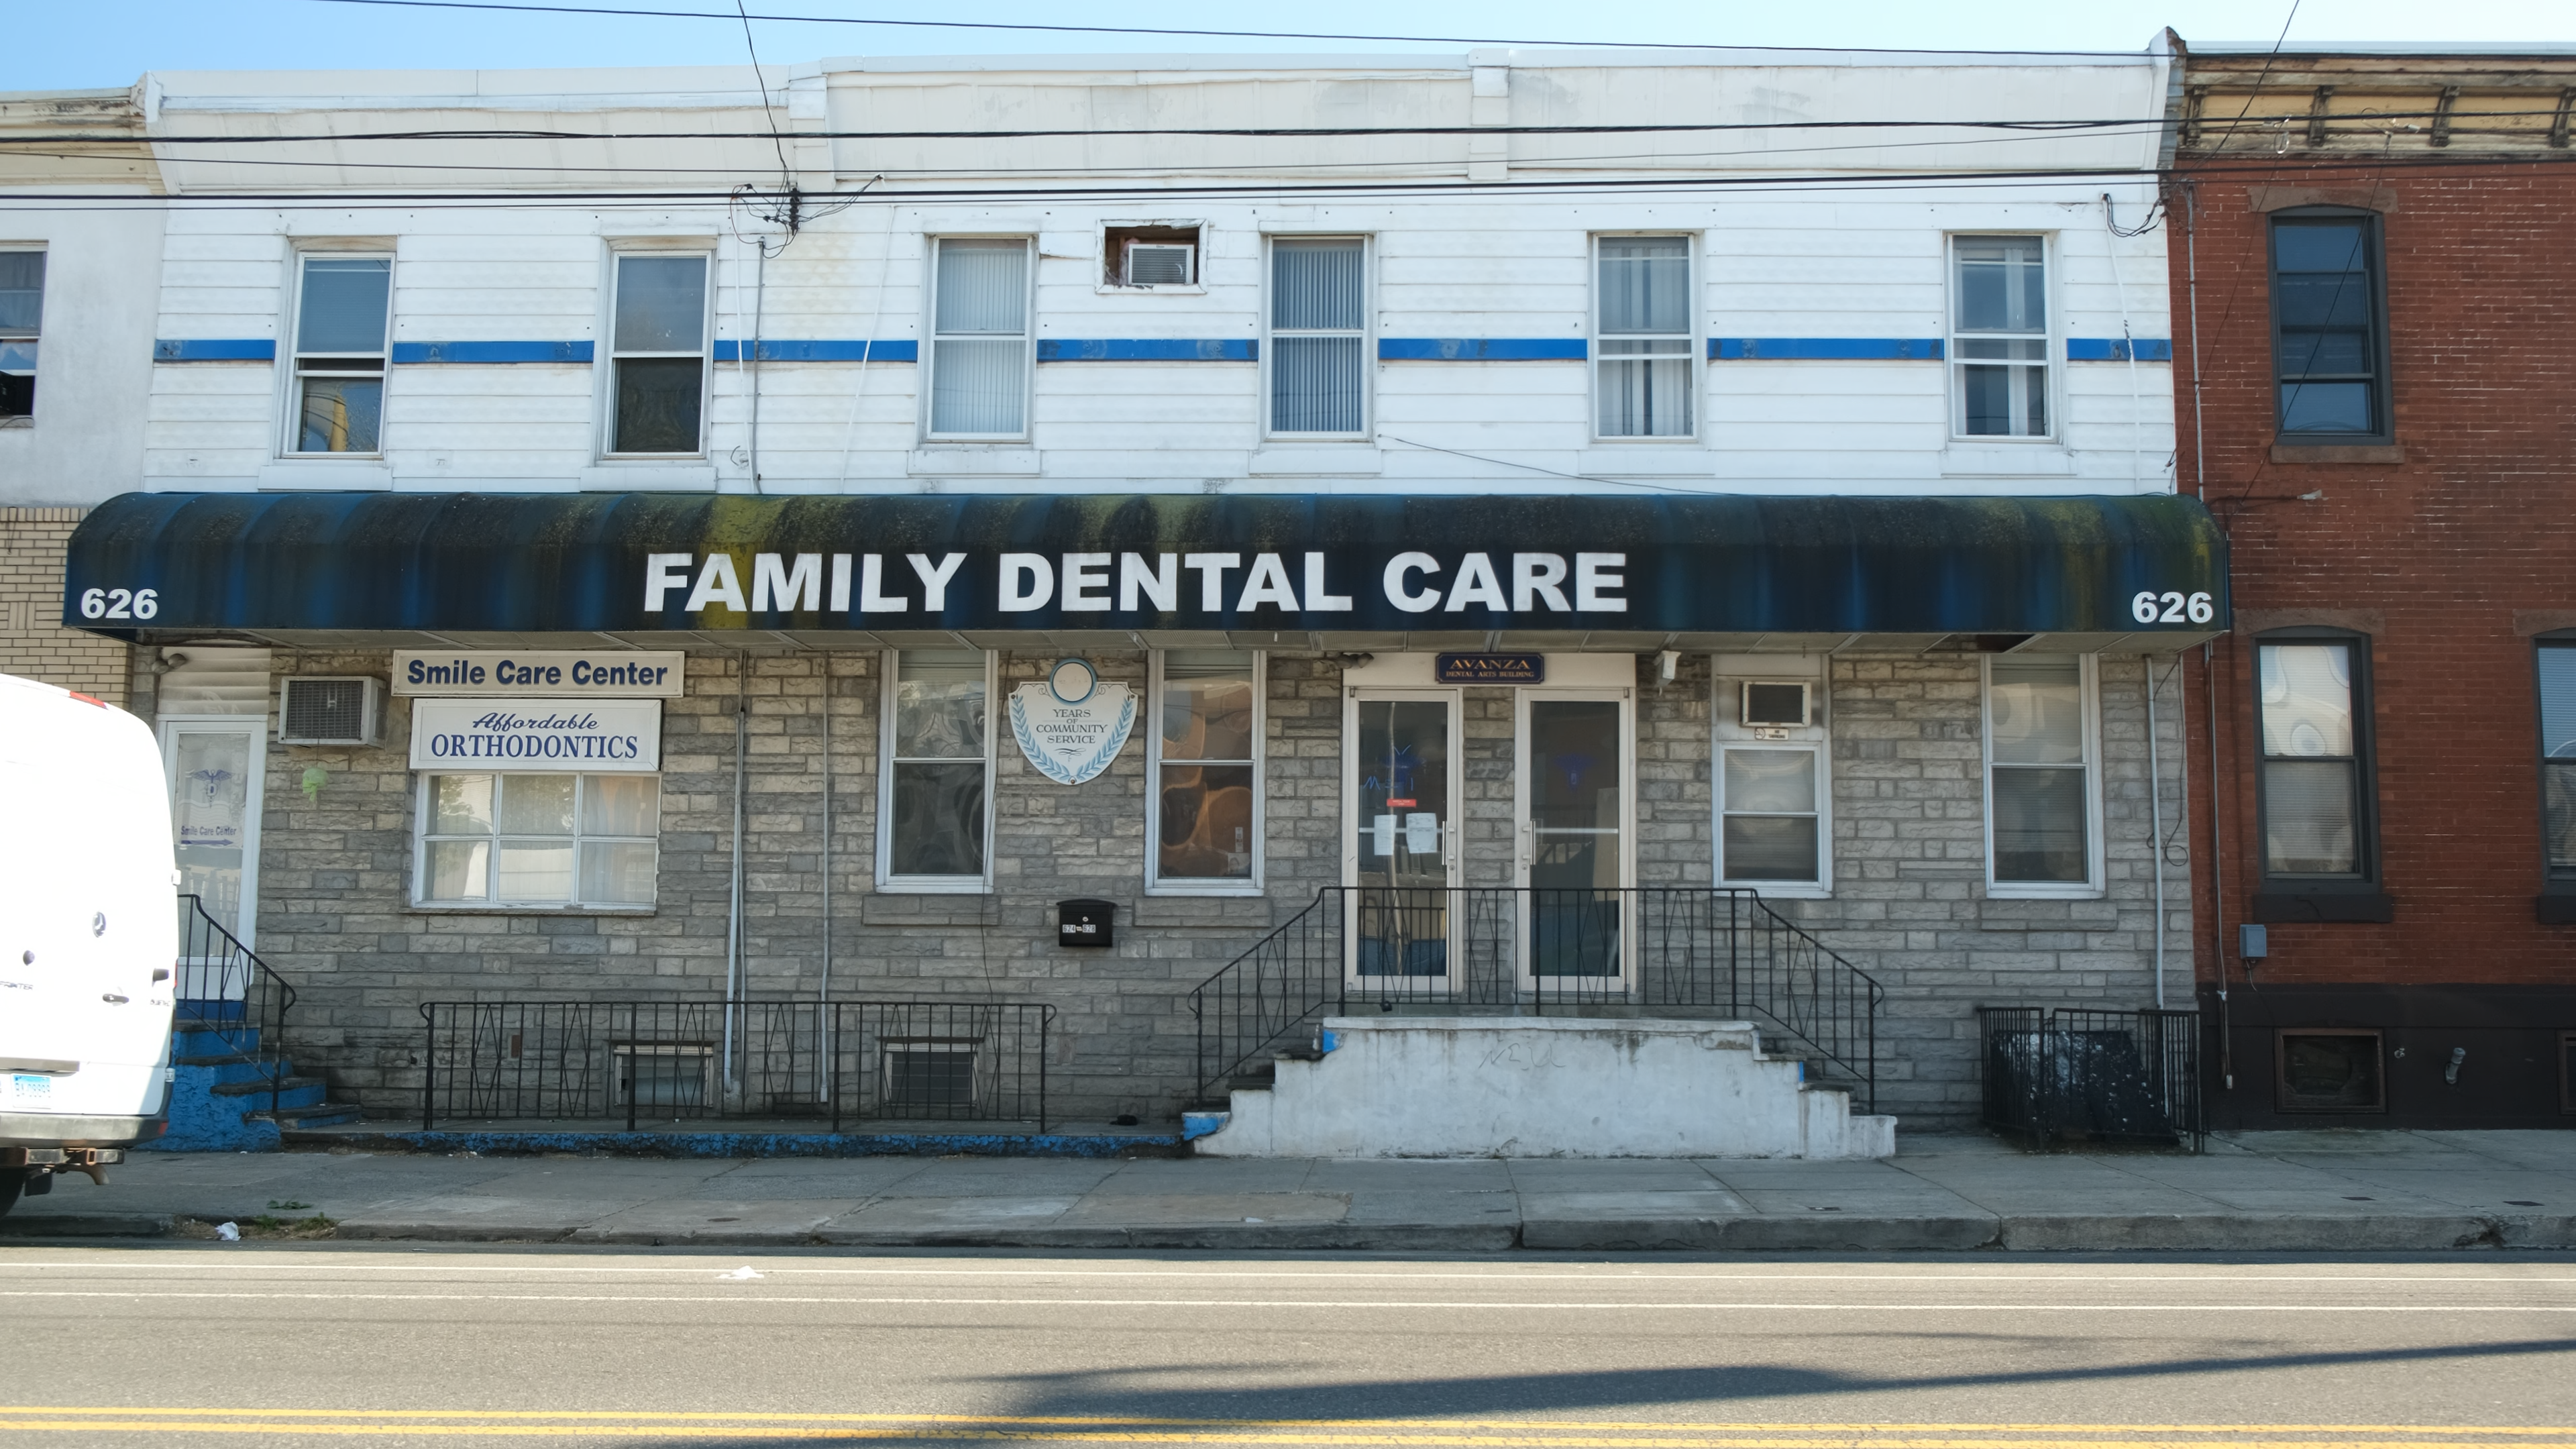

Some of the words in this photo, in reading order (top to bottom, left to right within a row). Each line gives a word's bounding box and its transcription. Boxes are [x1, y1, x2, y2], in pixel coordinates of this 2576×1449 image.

[644, 552, 967, 612] FAMILY
[998, 552, 1353, 612] DENTAL
[1383, 551, 1627, 612] CARE
[81, 588, 158, 620] 626
[2132, 591, 2213, 623] 626
[407, 659, 486, 684] Smile
[496, 659, 562, 685] Care
[572, 660, 668, 686] Center
[1449, 659, 1531, 669] AVANZA
[472, 712, 600, 733] Affordable
[1053, 709, 1091, 718] YEARS
[1036, 724, 1108, 733] COMMUNITY
[431, 734, 638, 759] ORTHODONTICS
[1046, 735, 1096, 744] SERVICE
[180, 825, 198, 835] Smile
[199, 826, 214, 835] Care
[215, 826, 237, 836] Center
